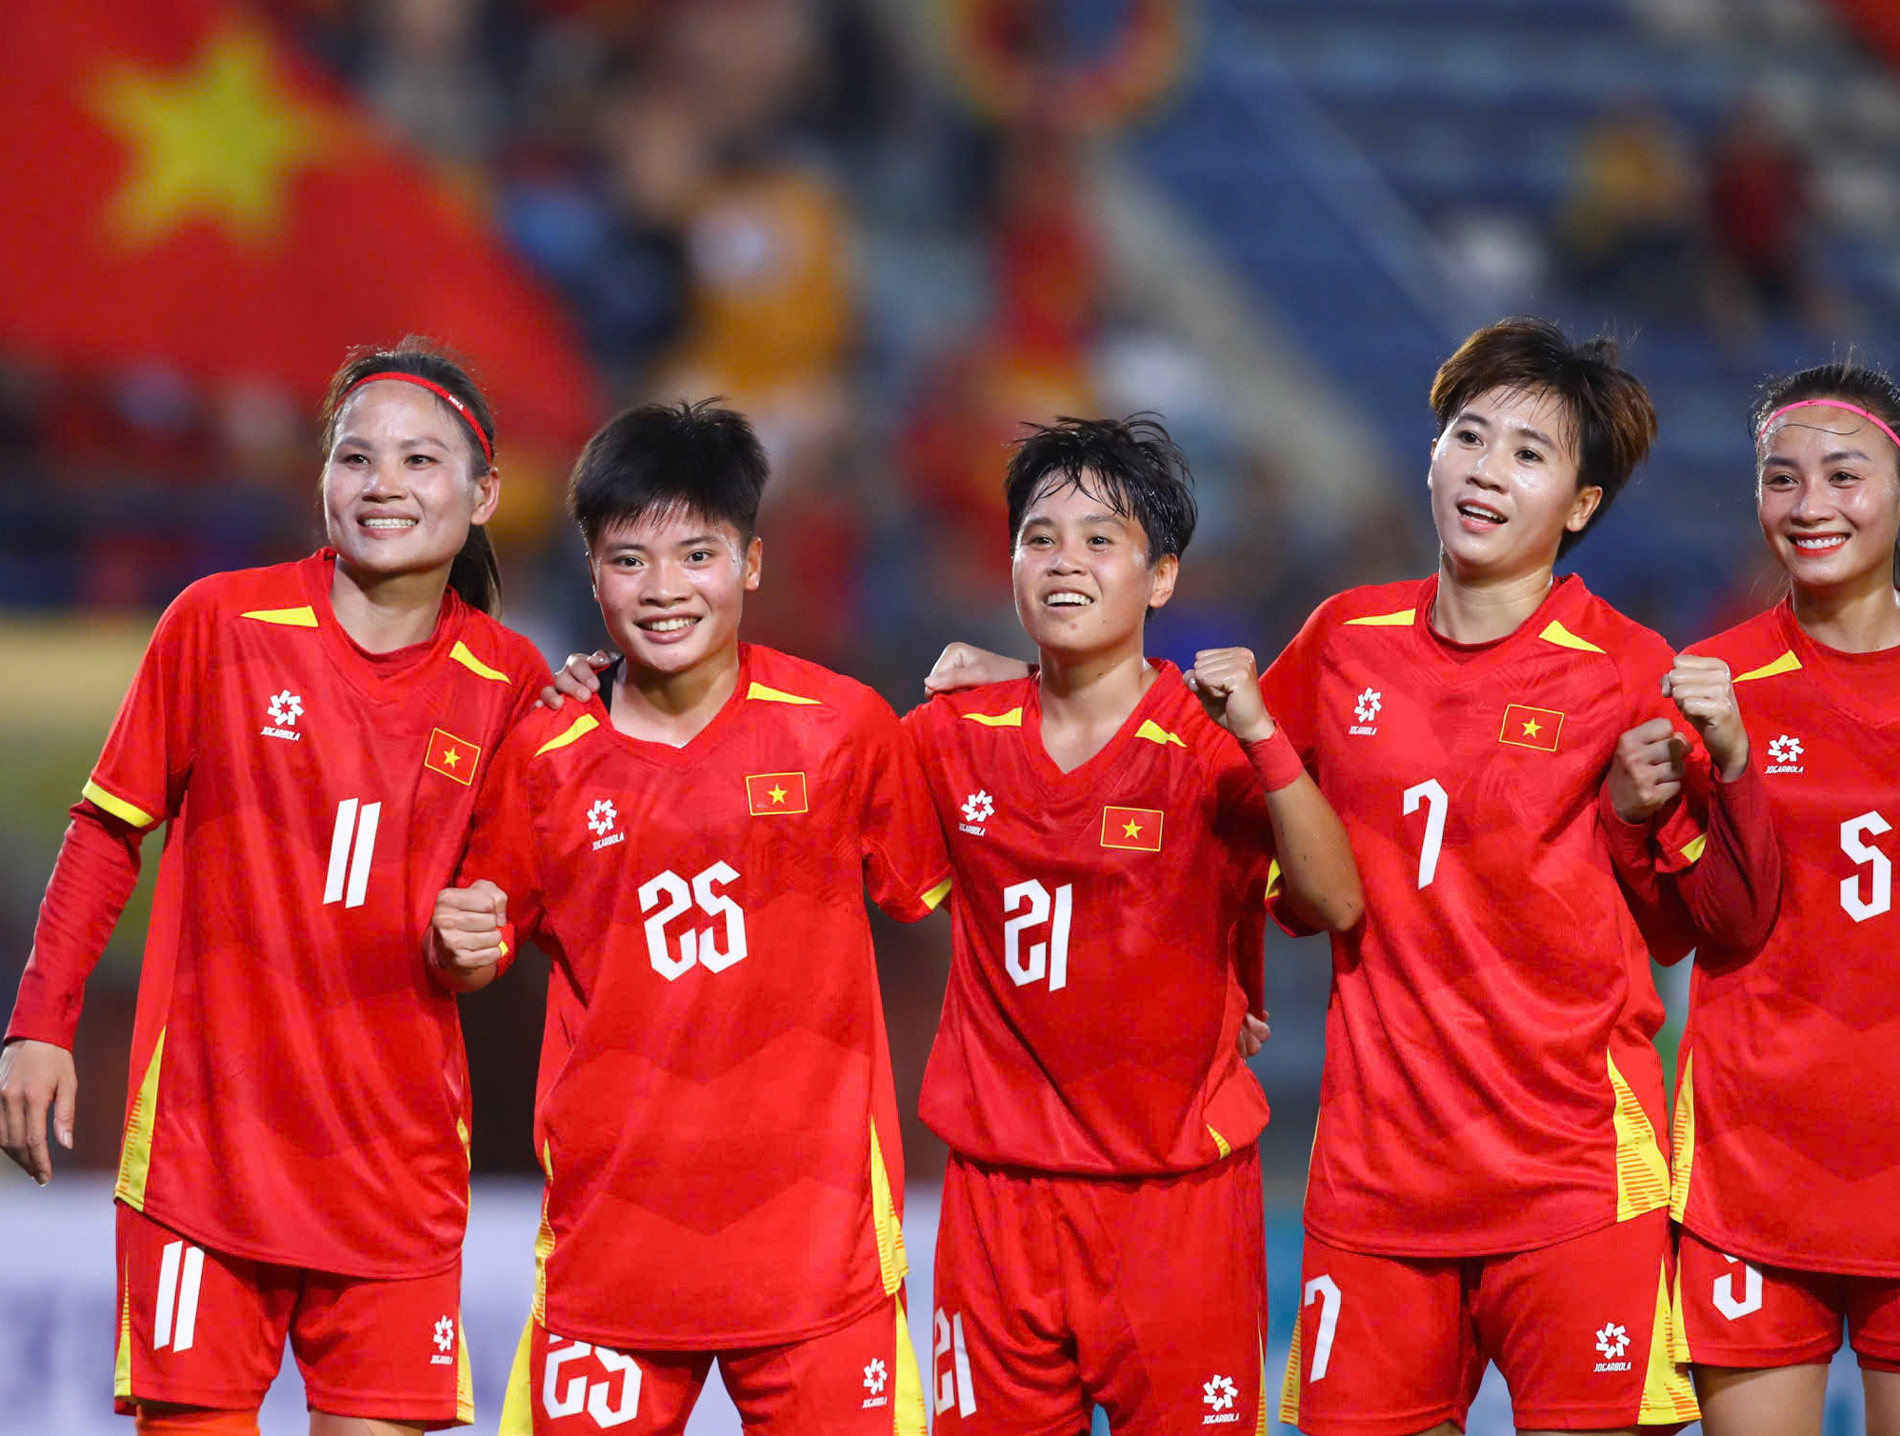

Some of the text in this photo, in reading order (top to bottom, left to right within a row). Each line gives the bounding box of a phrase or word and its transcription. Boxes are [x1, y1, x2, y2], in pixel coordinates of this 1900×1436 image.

[260, 725, 301, 742] JOGARBOLA
[1764, 765, 1804, 775] JOGARBOLA
[323, 797, 381, 908] 11
[1402, 777, 1448, 890] 7
[1839, 810, 1893, 923] 5
[637, 860, 748, 982] 25
[1004, 878, 1073, 992] 21
[153, 1240, 205, 1353] 11
[1304, 1273, 1342, 1384] 7
[542, 1333, 643, 1429] 25
[934, 1306, 977, 1419] 21
[1593, 1361, 1632, 1373] JOGARBOLA
[1202, 1412, 1240, 1426] JOGARBOLA
